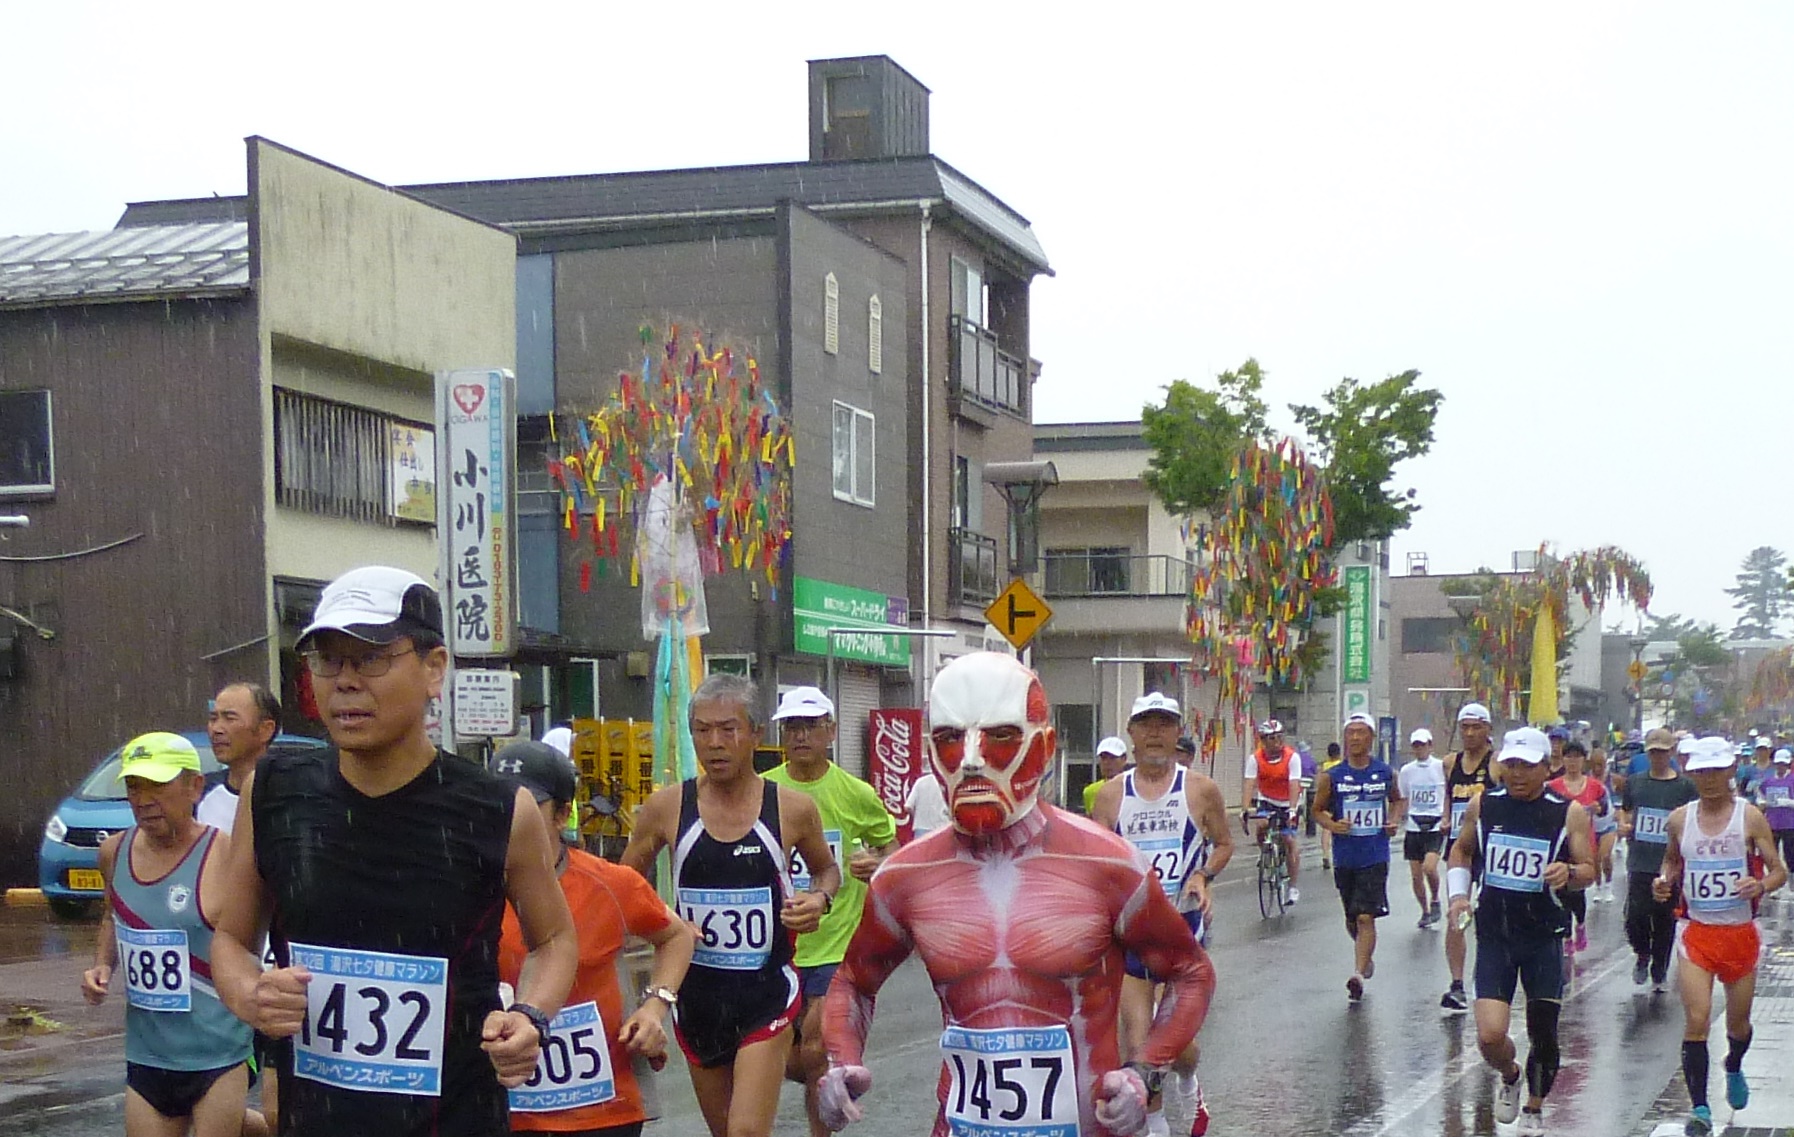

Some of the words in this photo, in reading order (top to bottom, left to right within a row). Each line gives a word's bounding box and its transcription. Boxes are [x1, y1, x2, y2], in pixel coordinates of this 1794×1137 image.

[453, 447, 489, 641] 小川医院
[1349, 692, 1365, 711] P
[1412, 790, 1437, 803] 1605
[1347, 809, 1380, 827] 1461
[1489, 846, 1544, 879] 1403
[304, 1058, 425, 1087] アルペンスポーツ
[952, 1053, 1063, 1121] 1457
